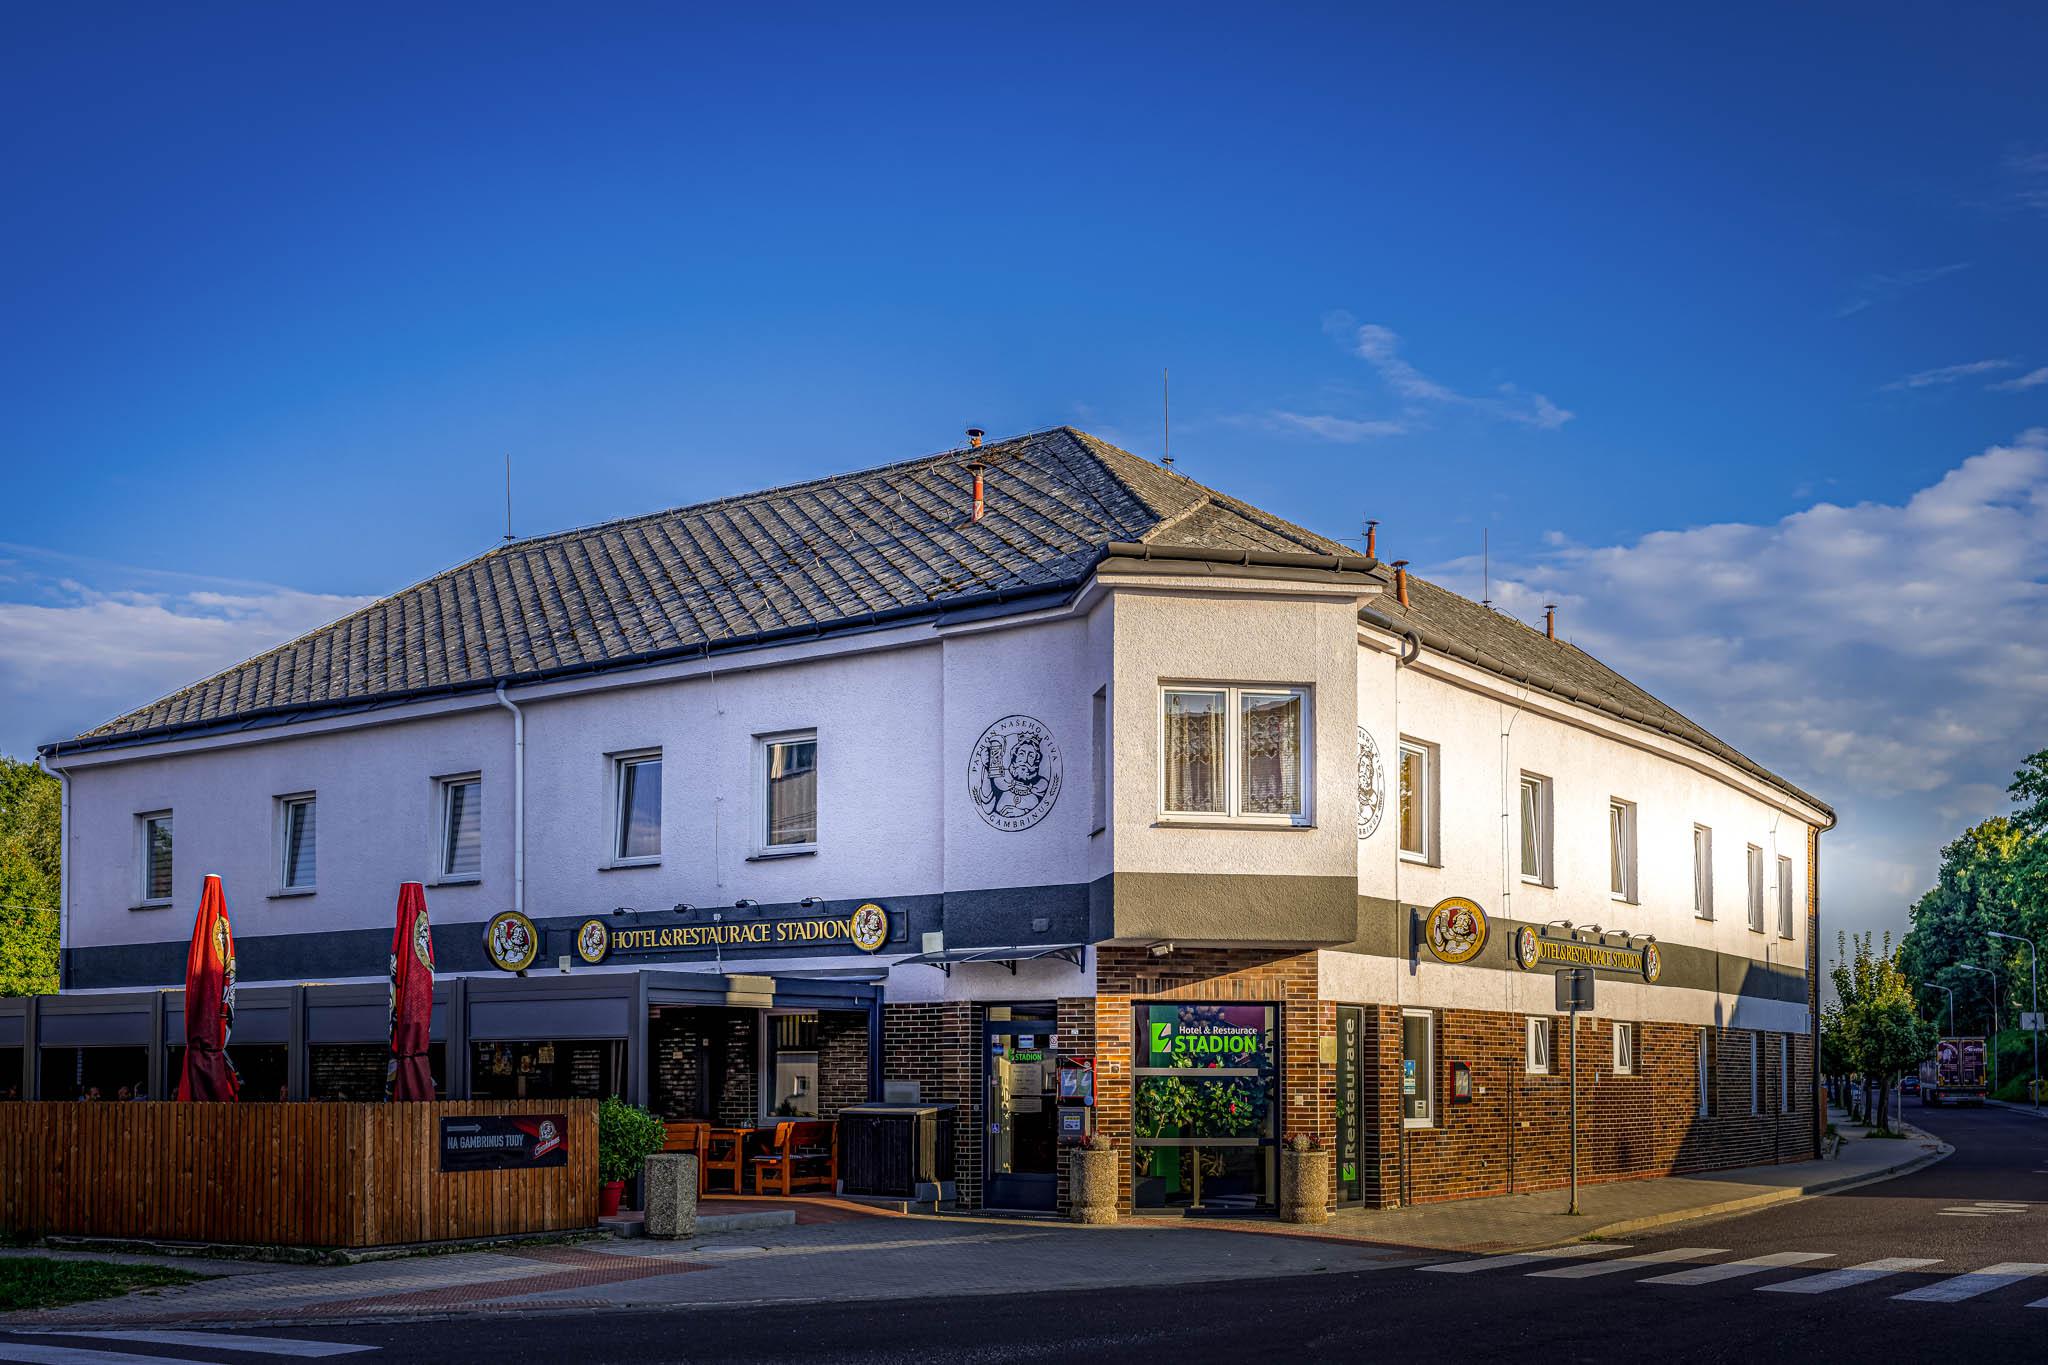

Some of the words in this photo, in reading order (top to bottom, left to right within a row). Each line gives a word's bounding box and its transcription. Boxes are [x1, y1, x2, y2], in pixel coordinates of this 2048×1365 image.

[1044, 735, 1058, 761] PIVA
[989, 800, 1050, 829] GAMBRINUS
[777, 920, 850, 942] STADION
[1612, 951, 1641, 969] STADION
[1179, 1026, 1202, 1035] Hotel
[1204, 1026, 1211, 1035] &
[1213, 1026, 1258, 1035] Restaurace
[1175, 1035, 1257, 1053] STADION
[1015, 1053, 1042, 1061] STADION
[1345, 1018, 1355, 1159] Restaurace
[447, 1136, 459, 1150] NA
[460, 1135, 504, 1149] GAMBRINUS
[505, 1134, 525, 1147] TUDY
